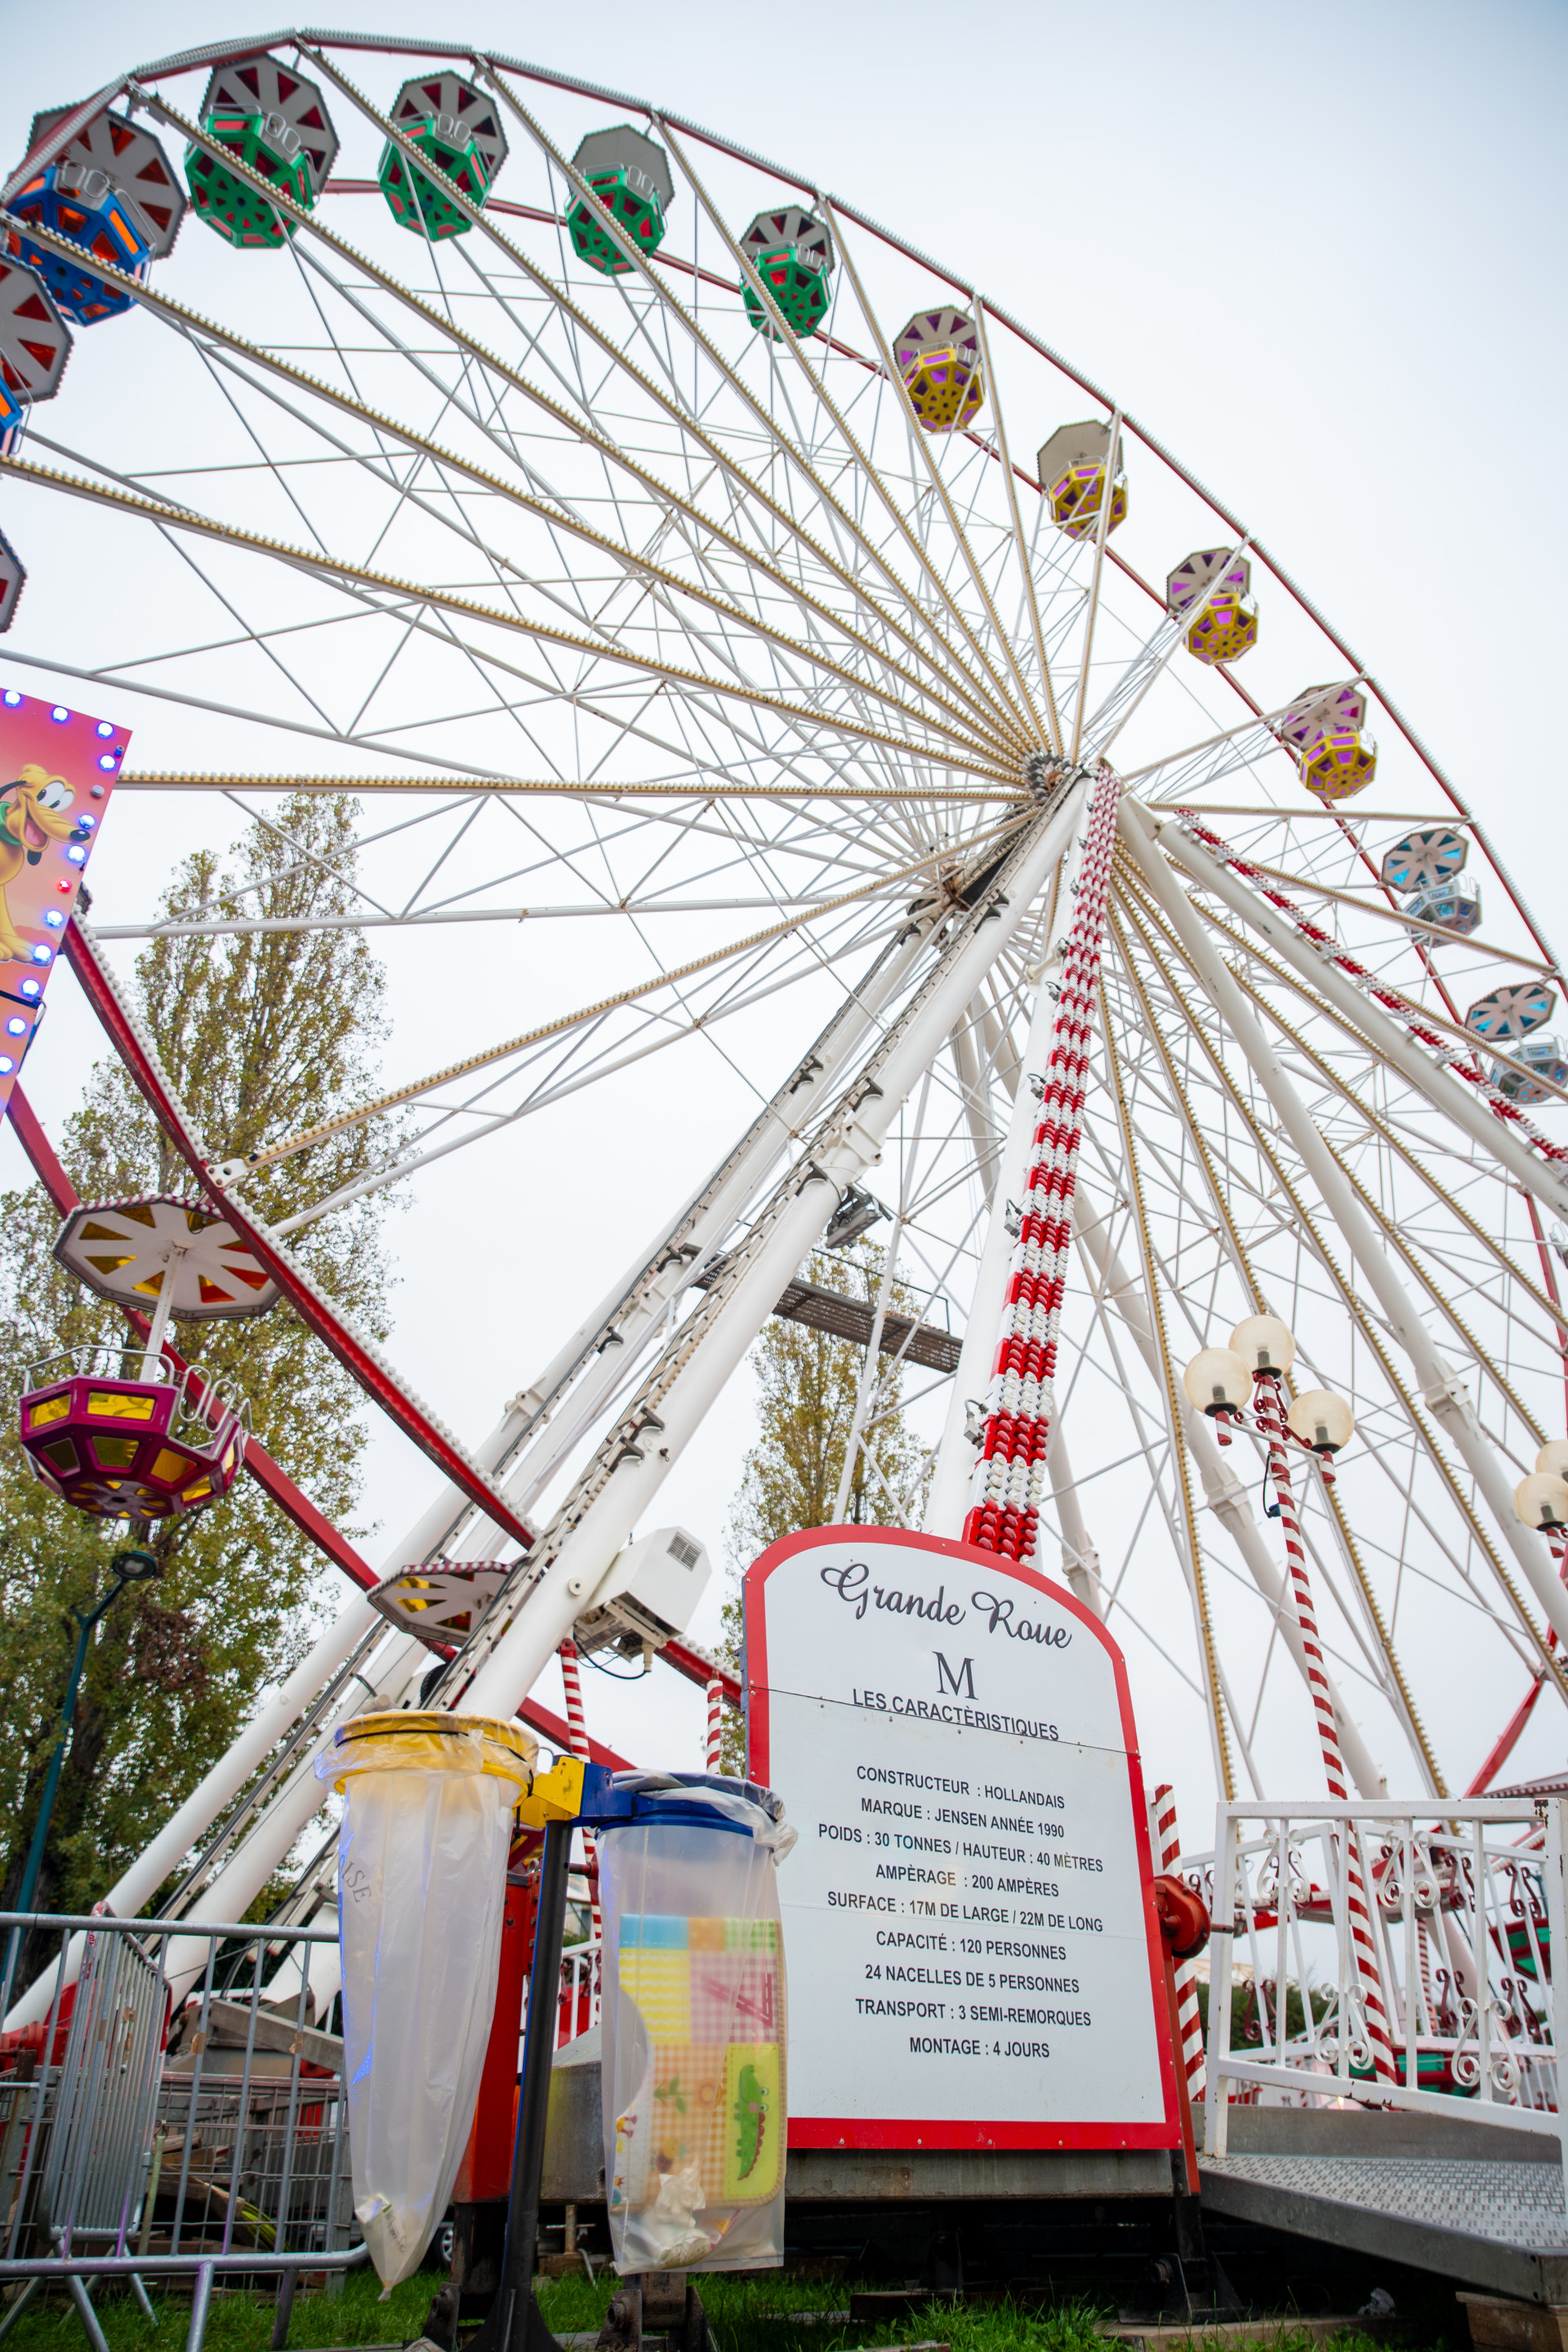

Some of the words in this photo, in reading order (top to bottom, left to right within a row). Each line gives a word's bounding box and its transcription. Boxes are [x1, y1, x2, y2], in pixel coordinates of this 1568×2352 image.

[821, 1564, 965, 1625] Grande
[972, 1592, 1071, 1648] Roue
[933, 1651, 978, 1699] M
[853, 1688, 887, 1710] LES
[892, 1696, 1059, 1741] CARACTÈRISTIQUES
[858, 1766, 969, 1794] CONSTRUCTEUR
[985, 1785, 1064, 1808] HOLLANDAIS
[862, 1798, 922, 1819] MARQUE
[935, 1809, 987, 1827] JENSEN
[991, 1816, 1034, 1833] ANNÉE
[1038, 1823, 1063, 1838] 1990
[819, 1824, 862, 1842] POIDS
[875, 1832, 889, 1846] 30
[894, 1834, 951, 1853] TONNES
[956, 1841, 960, 1855] /
[964, 1842, 1026, 1862] HAUTEUR
[1037, 1852, 1049, 1865] 40
[1054, 1854, 1102, 1872] MÈTRES
[876, 1864, 956, 1885] AMPÈRAGE
[973, 1875, 993, 1890] 200
[997, 1878, 1058, 1896] AMPÈRES
[828, 1891, 896, 1912] SURFACE
[910, 1900, 935, 1915] 17M
[941, 1904, 959, 1918] DE
[964, 1905, 1009, 1922] LARGE
[1013, 1910, 1016, 1924] /
[1020, 1912, 1044, 1926] 22M
[1049, 1914, 1065, 1928] DE
[1069, 1916, 1102, 1931] LONG
[877, 1931, 947, 1950] CAPACITÉ
[960, 1939, 982, 1953] 120
[987, 1940, 1066, 1960] PERSONNES
[866, 1964, 881, 1979] 24
[886, 1966, 961, 1985] NACELLES
[966, 1972, 984, 1986] DE
[989, 1974, 996, 1987] 5
[1000, 1975, 1079, 1993] PERSONNES
[856, 1998, 945, 2018] TRANSPORT
[959, 2006, 965, 2020] 3
[971, 2006, 1091, 2026] SEMI-REMORQUES
[911, 2038, 980, 2055] MONTAGE
[993, 2042, 1000, 2056] 4
[1004, 2042, 1049, 2057] JOURS
